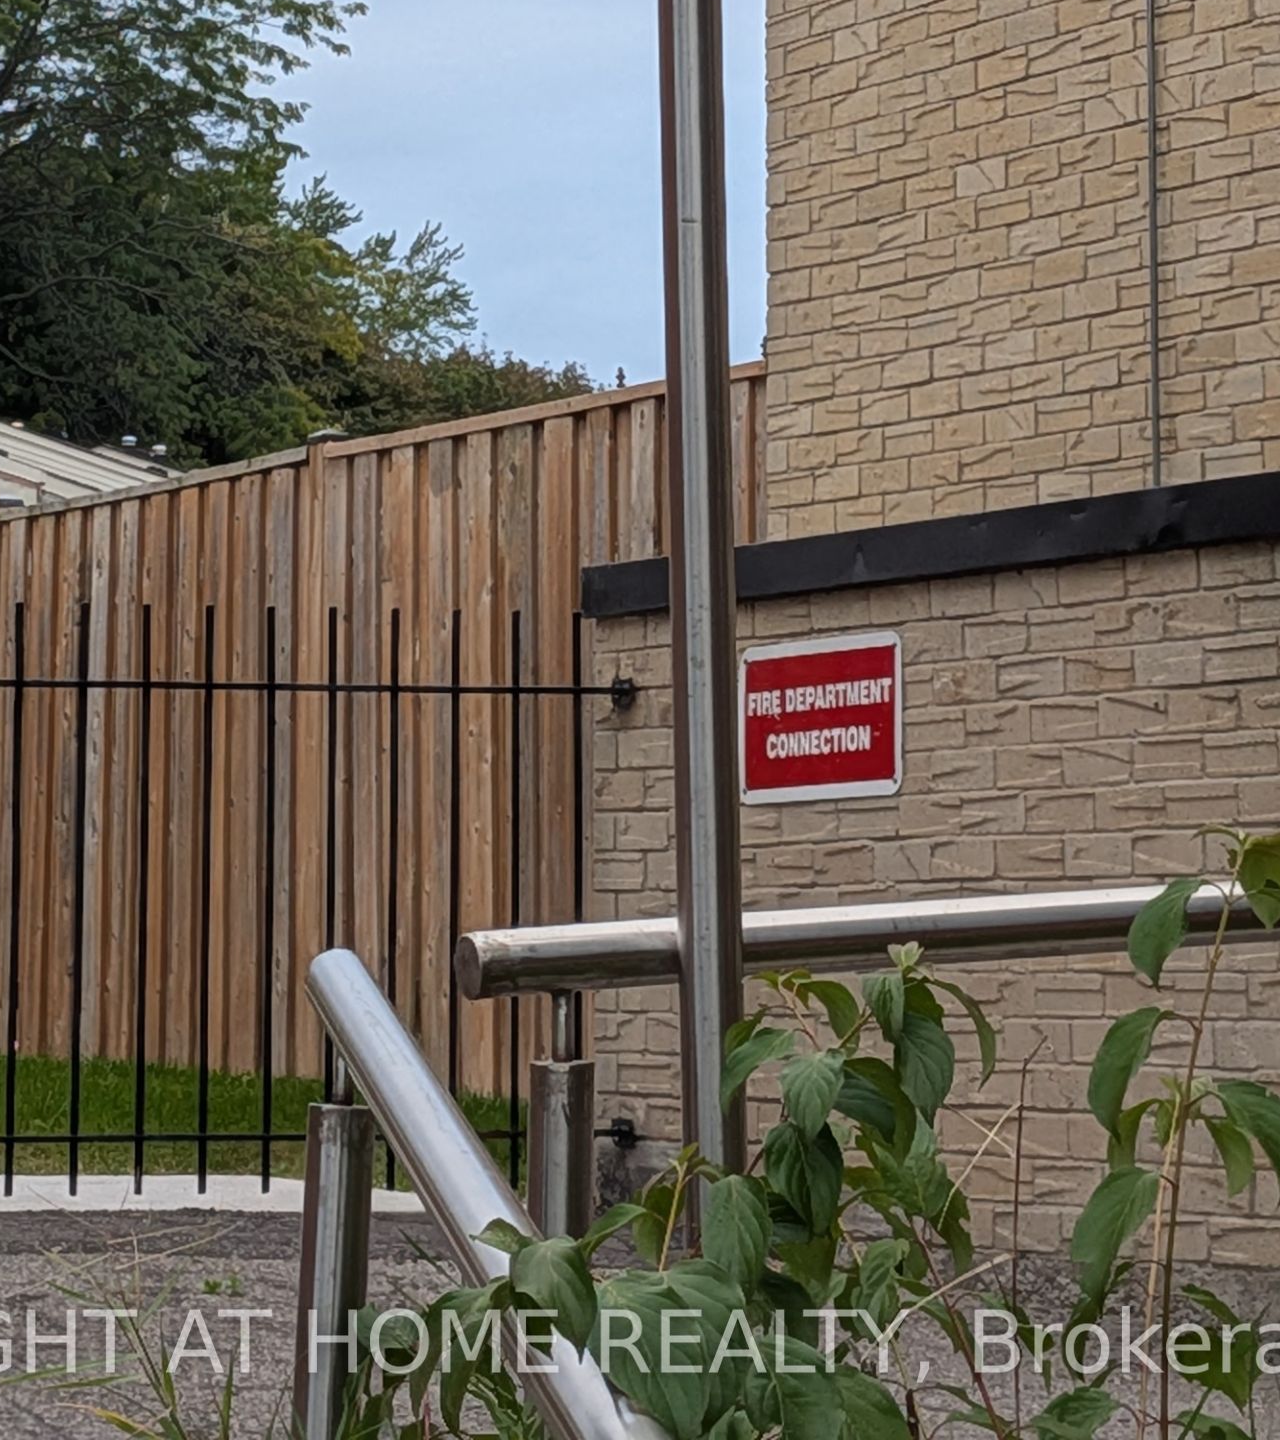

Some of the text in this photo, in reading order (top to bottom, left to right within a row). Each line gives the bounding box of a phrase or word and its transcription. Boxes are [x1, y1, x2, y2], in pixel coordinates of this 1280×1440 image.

[747, 677, 892, 716] FIRE DEPARTMENT
[766, 725, 871, 759] CONNECTION
